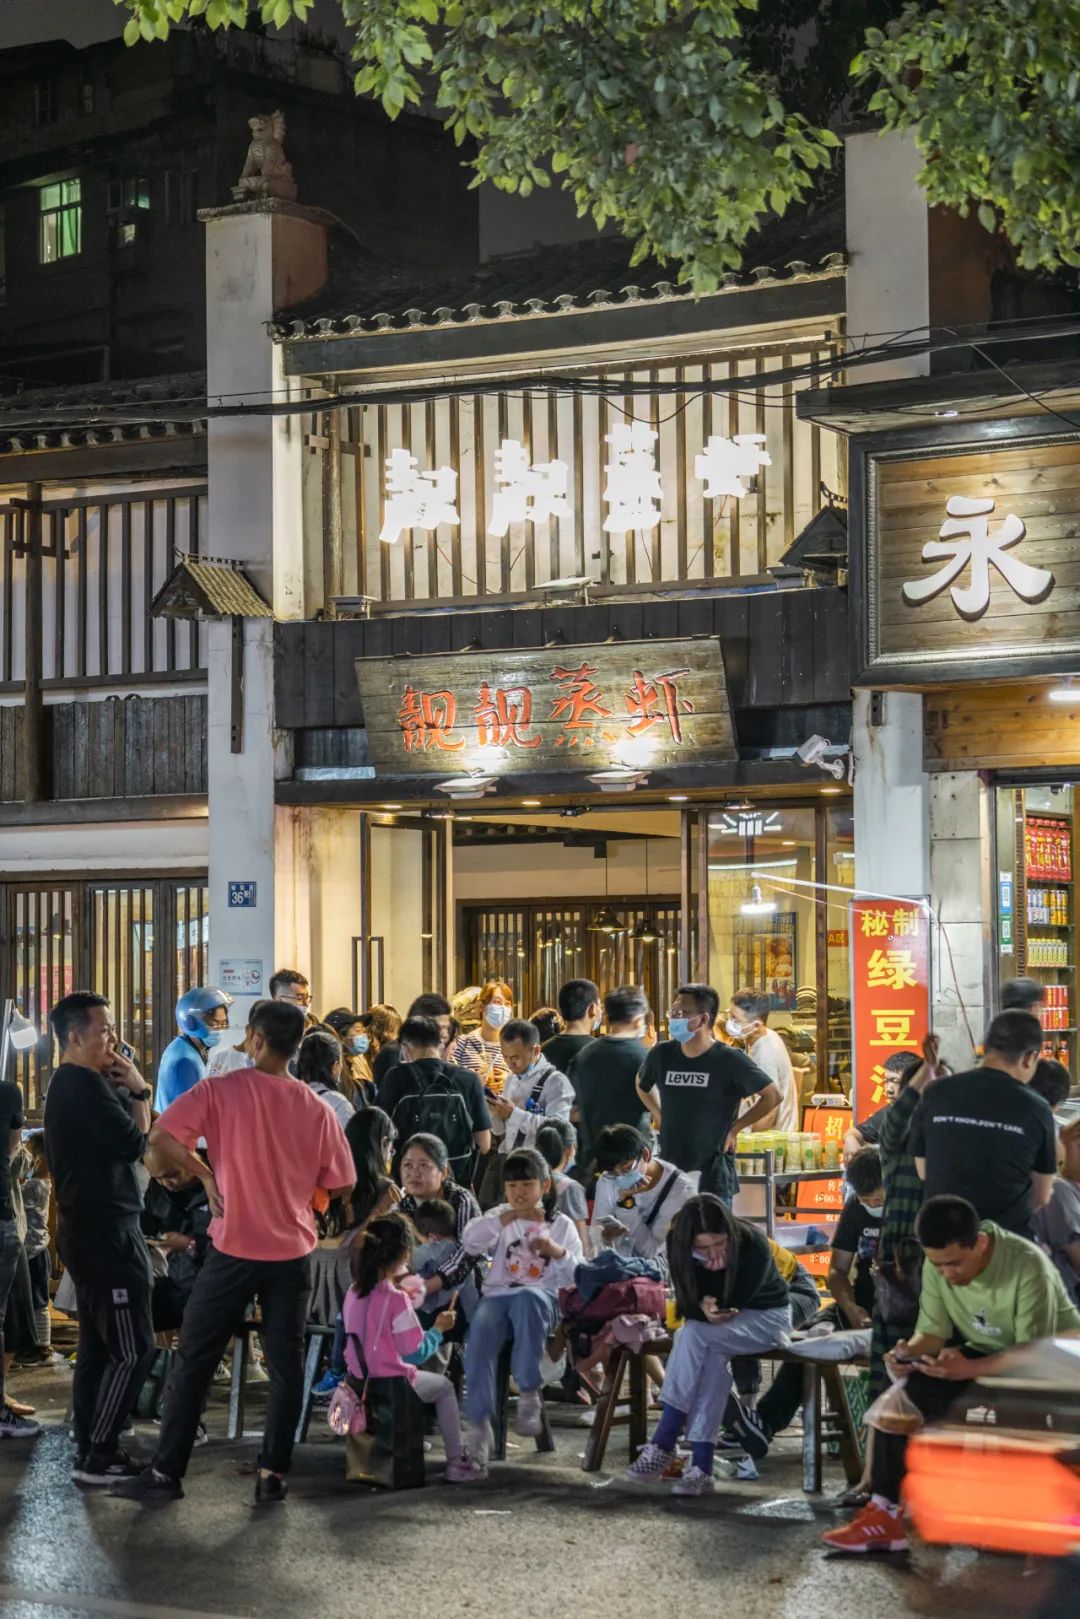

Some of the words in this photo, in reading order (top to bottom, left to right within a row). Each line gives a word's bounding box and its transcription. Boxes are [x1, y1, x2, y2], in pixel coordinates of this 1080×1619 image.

[902, 495, 1055, 622] 永
[399, 662, 696, 753] 靓靓蒸虾
[861, 907, 920, 937] 秘制
[866, 949, 919, 1105] 绿豆
